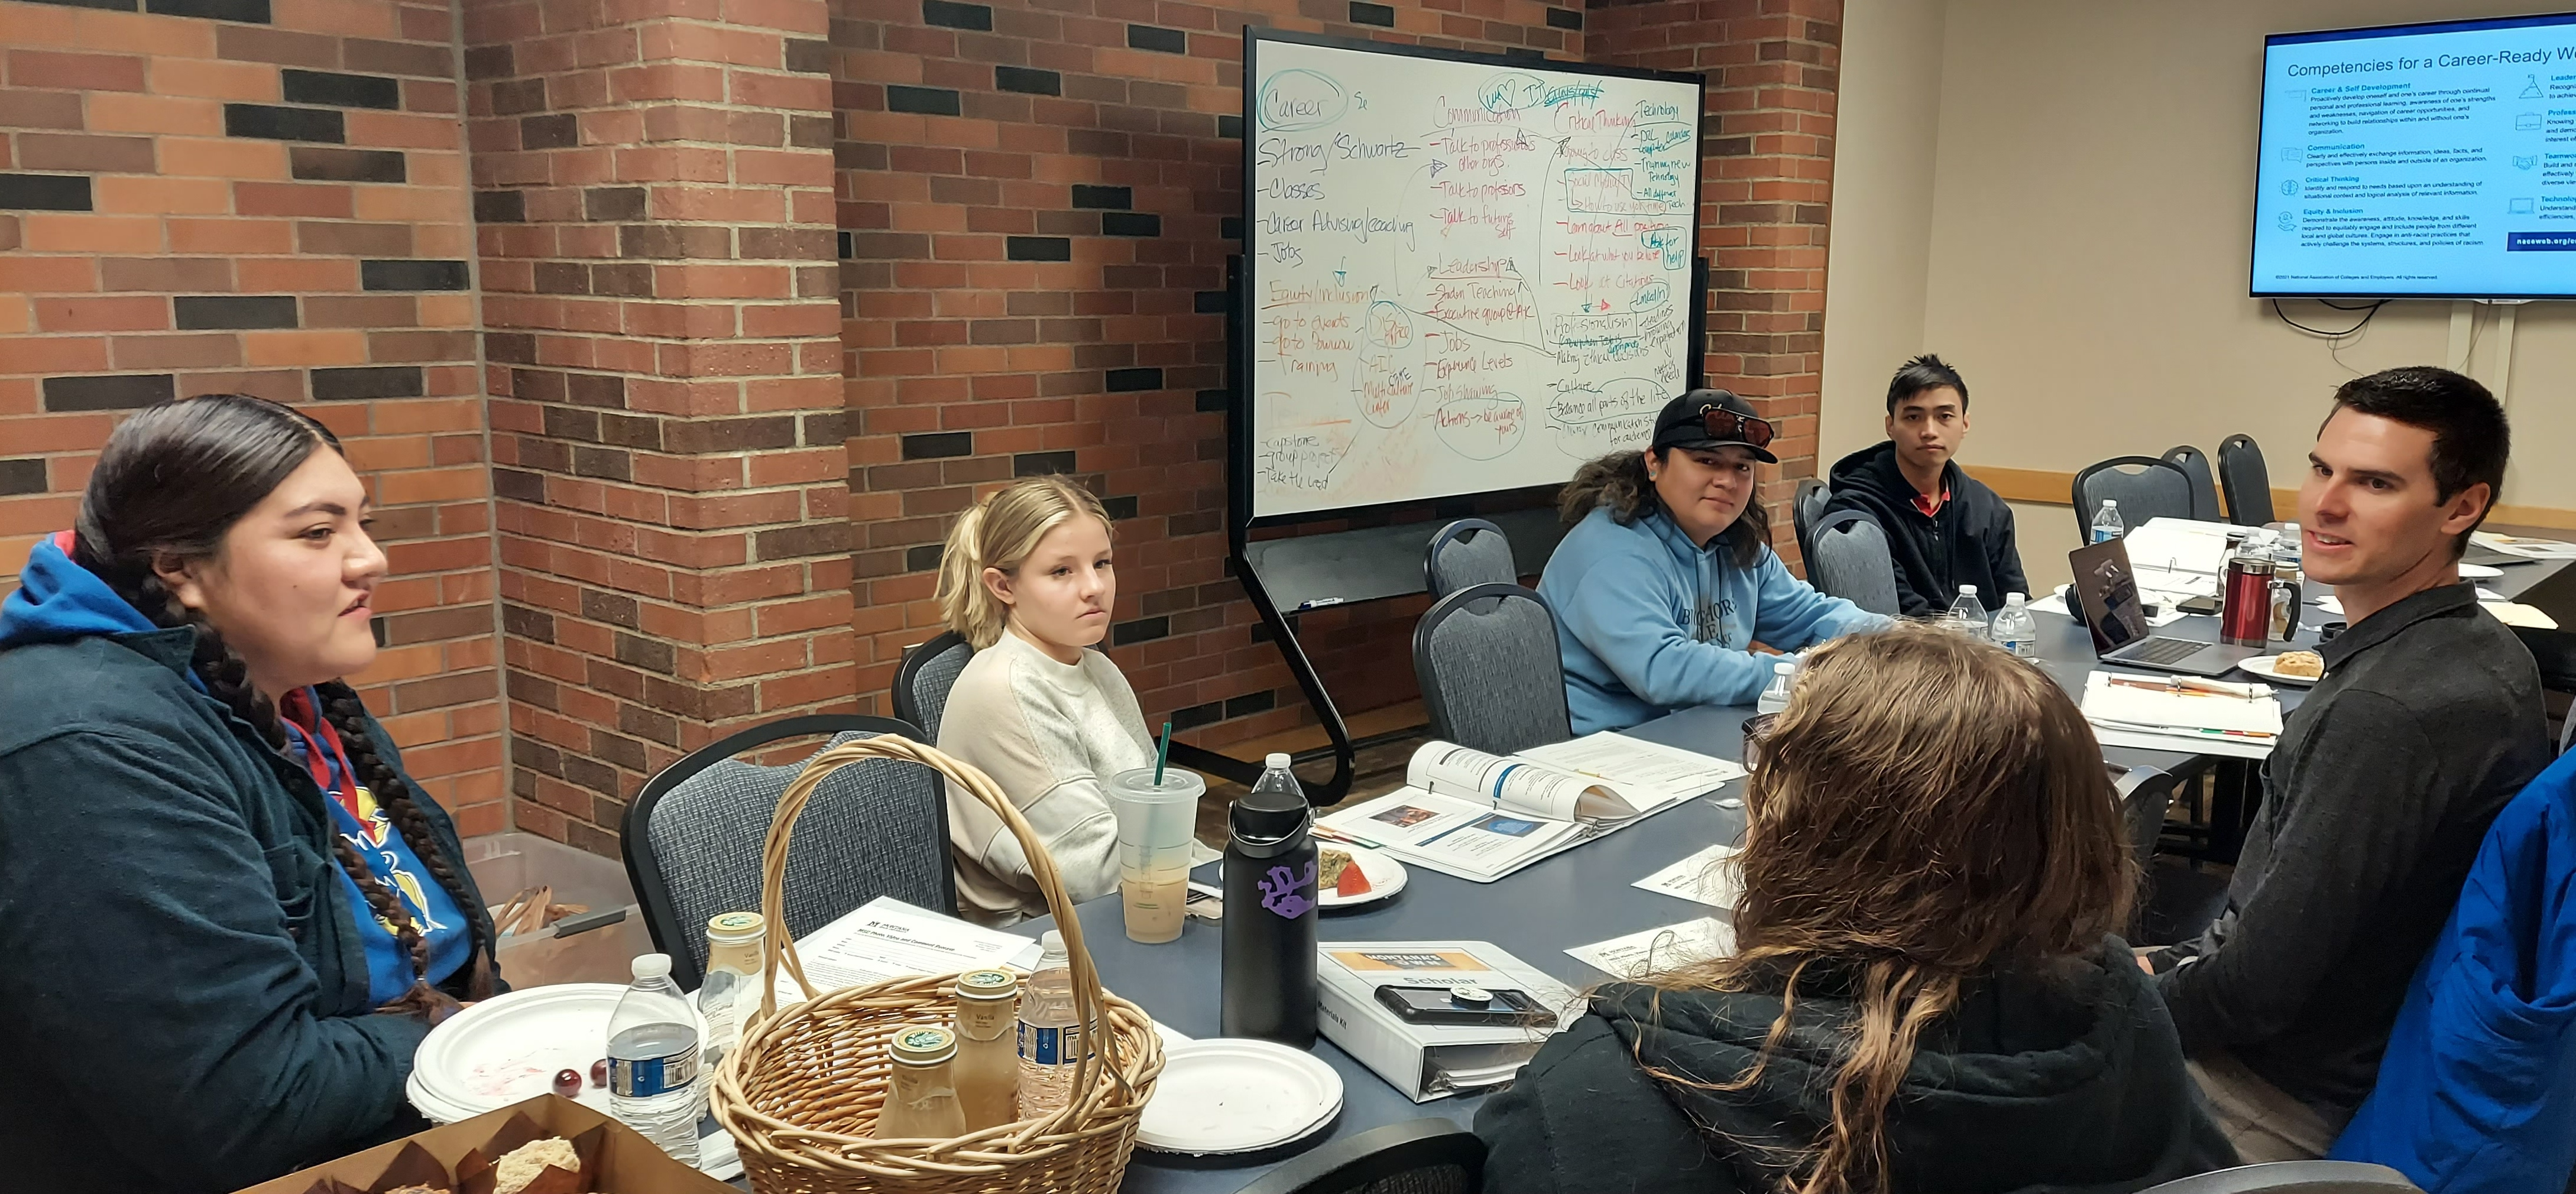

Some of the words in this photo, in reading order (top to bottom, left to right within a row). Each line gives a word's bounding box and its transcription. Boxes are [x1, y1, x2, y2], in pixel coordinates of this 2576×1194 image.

[2287, 59, 2393, 78] Competencies
[2399, 57, 2419, 70] for
[2423, 58, 2432, 68] a
[2438, 50, 2551, 67] Career-Ready
[2361, 83, 2410, 91] Development
[1265, 89, 1324, 124] Career
[1636, 100, 1679, 121] Technology
[1441, 135, 1467, 154] Talk
[1469, 136, 1479, 153] to
[1269, 177, 1324, 200] Classes
[1440, 181, 1466, 199] Talk
[1467, 182, 1478, 197] to
[1482, 183, 1527, 202] professors
[1440, 206, 1468, 223] Talk
[1469, 207, 1478, 223] to
[1667, 199, 1685, 209] Tech
[1271, 241, 1303, 268] Jobs
[1569, 244, 1589, 262] Look
[1667, 248, 1684, 268] help
[1438, 252, 1506, 277] Leadership
[1467, 283, 1517, 304] Teaching
[1294, 310, 1306, 330] to
[1311, 312, 1350, 331] events
[1292, 333, 1304, 350] to
[1439, 331, 1470, 354] Jobs
[1482, 351, 1513, 371] Levels
[1557, 379, 1595, 394] Culture
[1435, 408, 1470, 430] Actions
[1365, 953, 1442, 962] MONTANA'S
[1317, 1000, 1339, 1024] Materials
